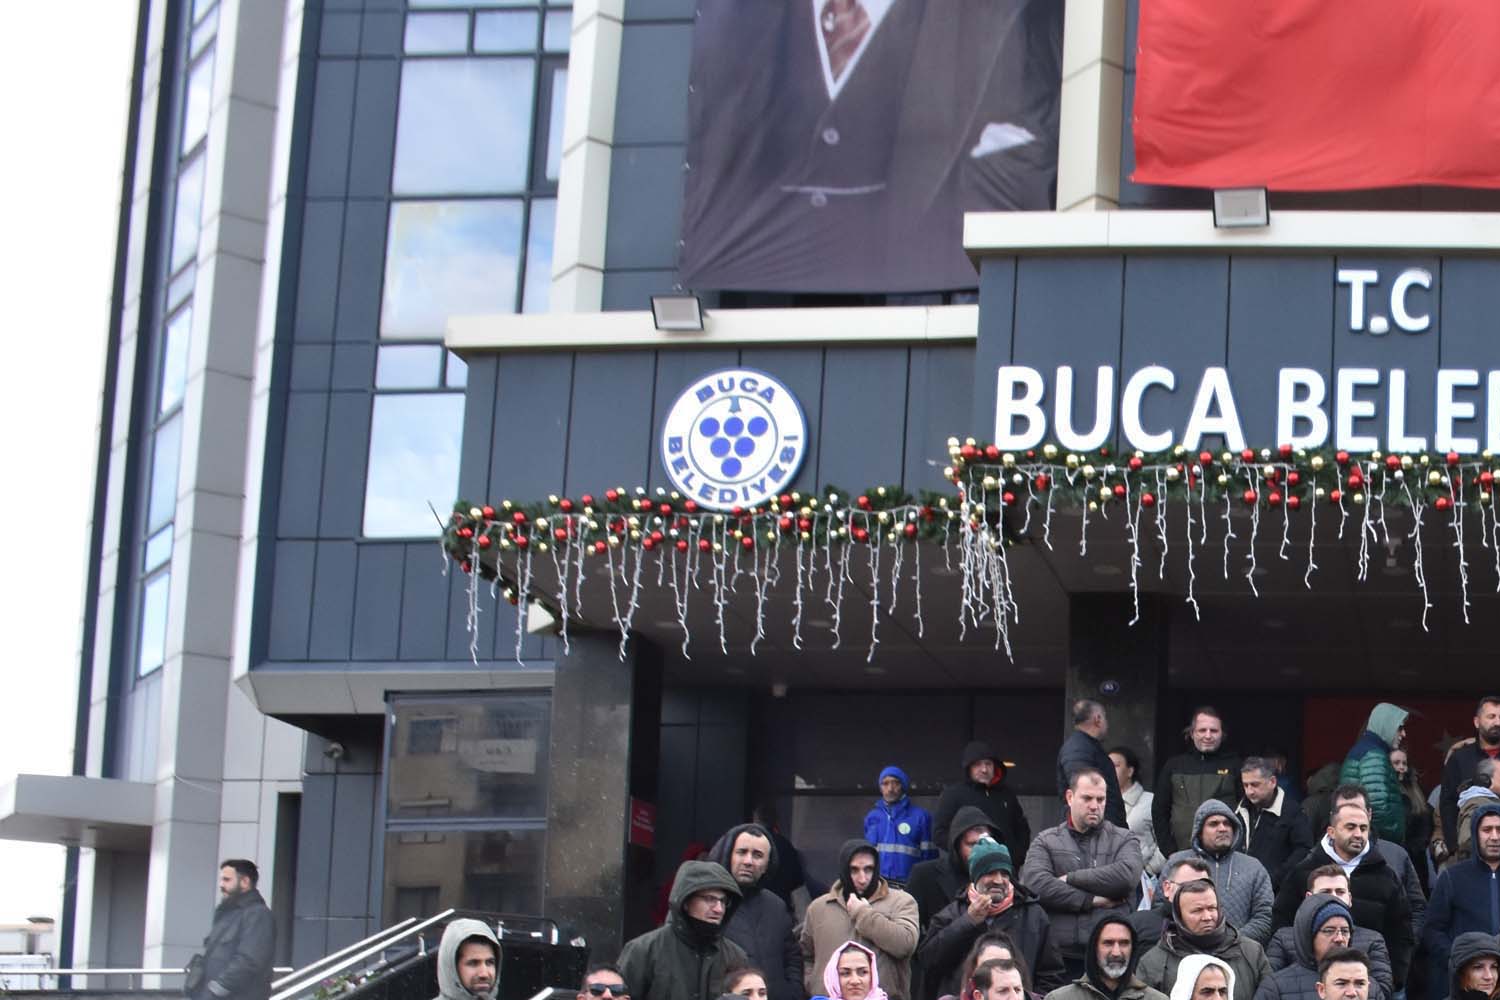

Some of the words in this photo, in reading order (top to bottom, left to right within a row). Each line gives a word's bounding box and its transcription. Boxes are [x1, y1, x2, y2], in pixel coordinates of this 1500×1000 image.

[1338, 268, 1432, 334] T.C
[695, 376, 775, 404] BUCA
[995, 366, 1247, 451] BUCA
